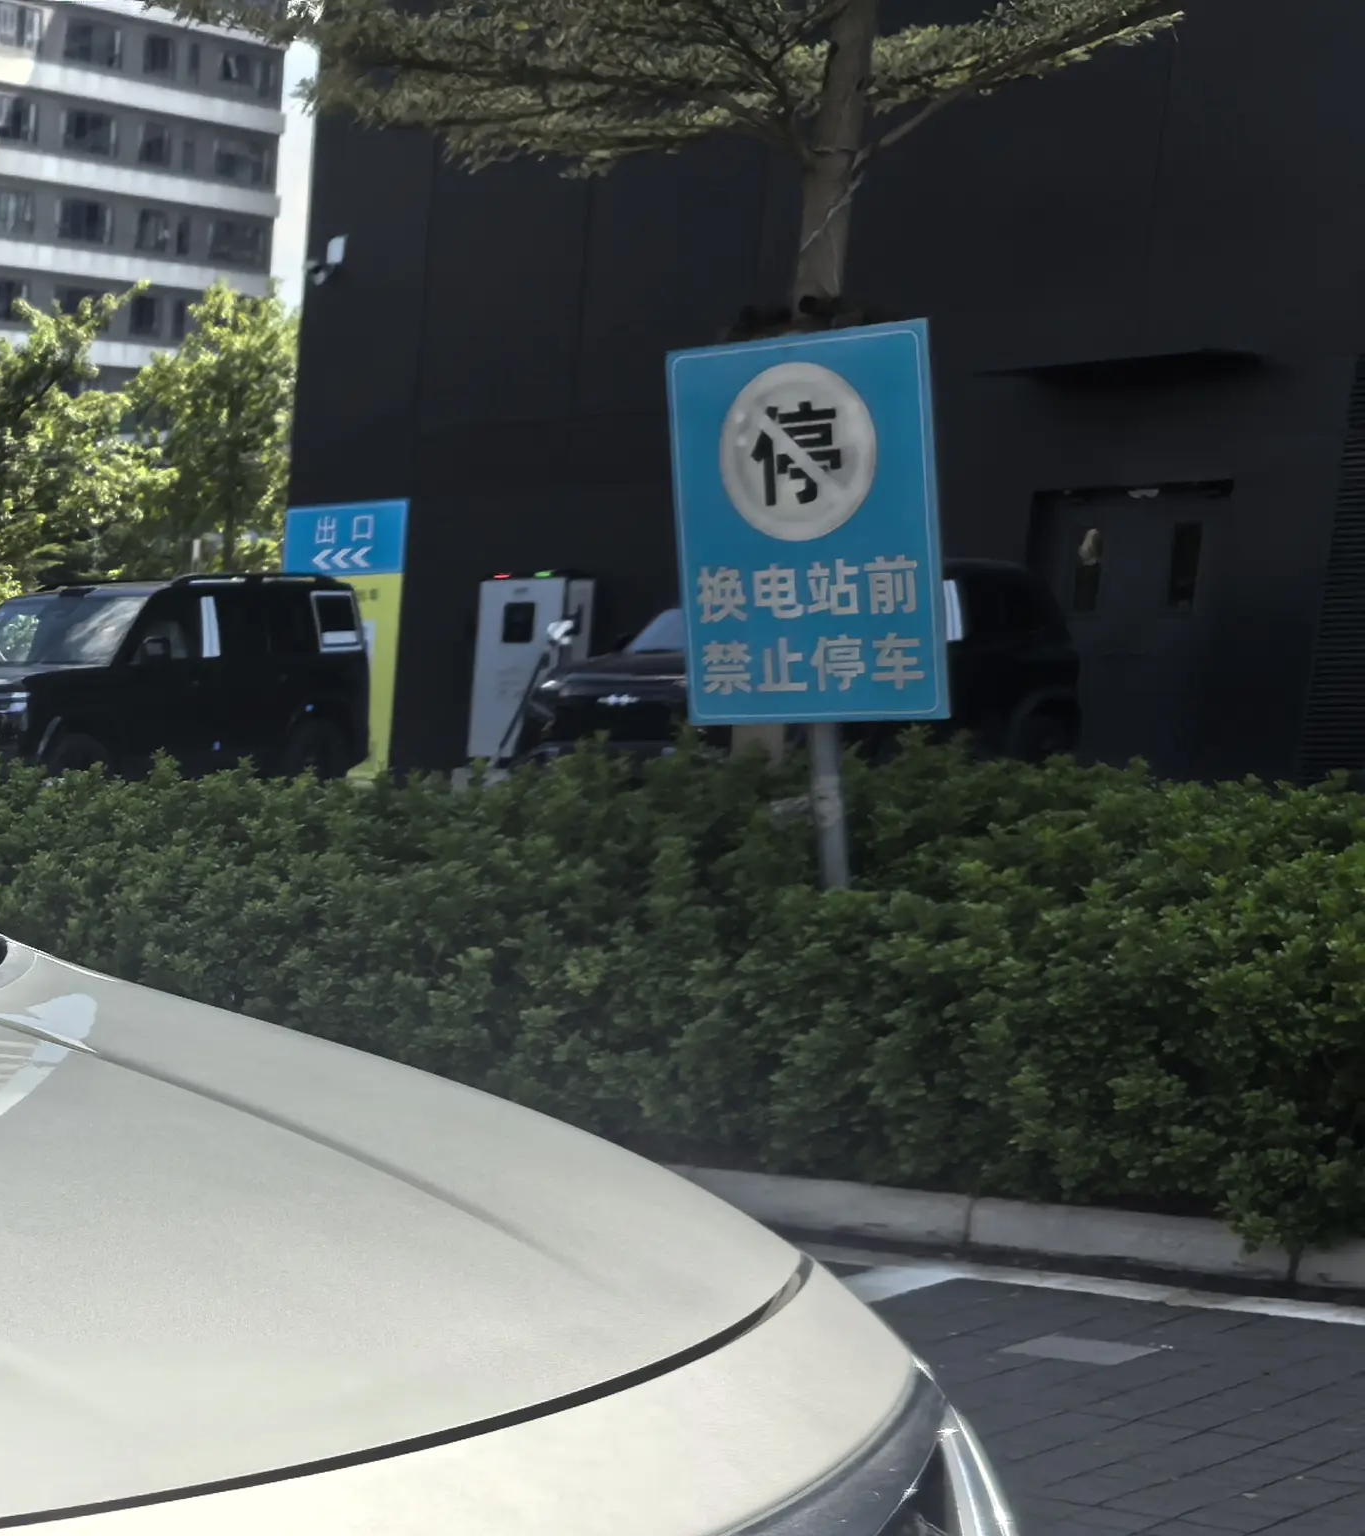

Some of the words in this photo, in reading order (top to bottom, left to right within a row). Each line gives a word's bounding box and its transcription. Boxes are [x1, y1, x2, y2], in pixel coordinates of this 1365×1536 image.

[751, 401, 841, 507] 停
[315, 515, 374, 543] 出口
[697, 555, 918, 624] 换电站前
[702, 632, 925, 695] 禁止停车
